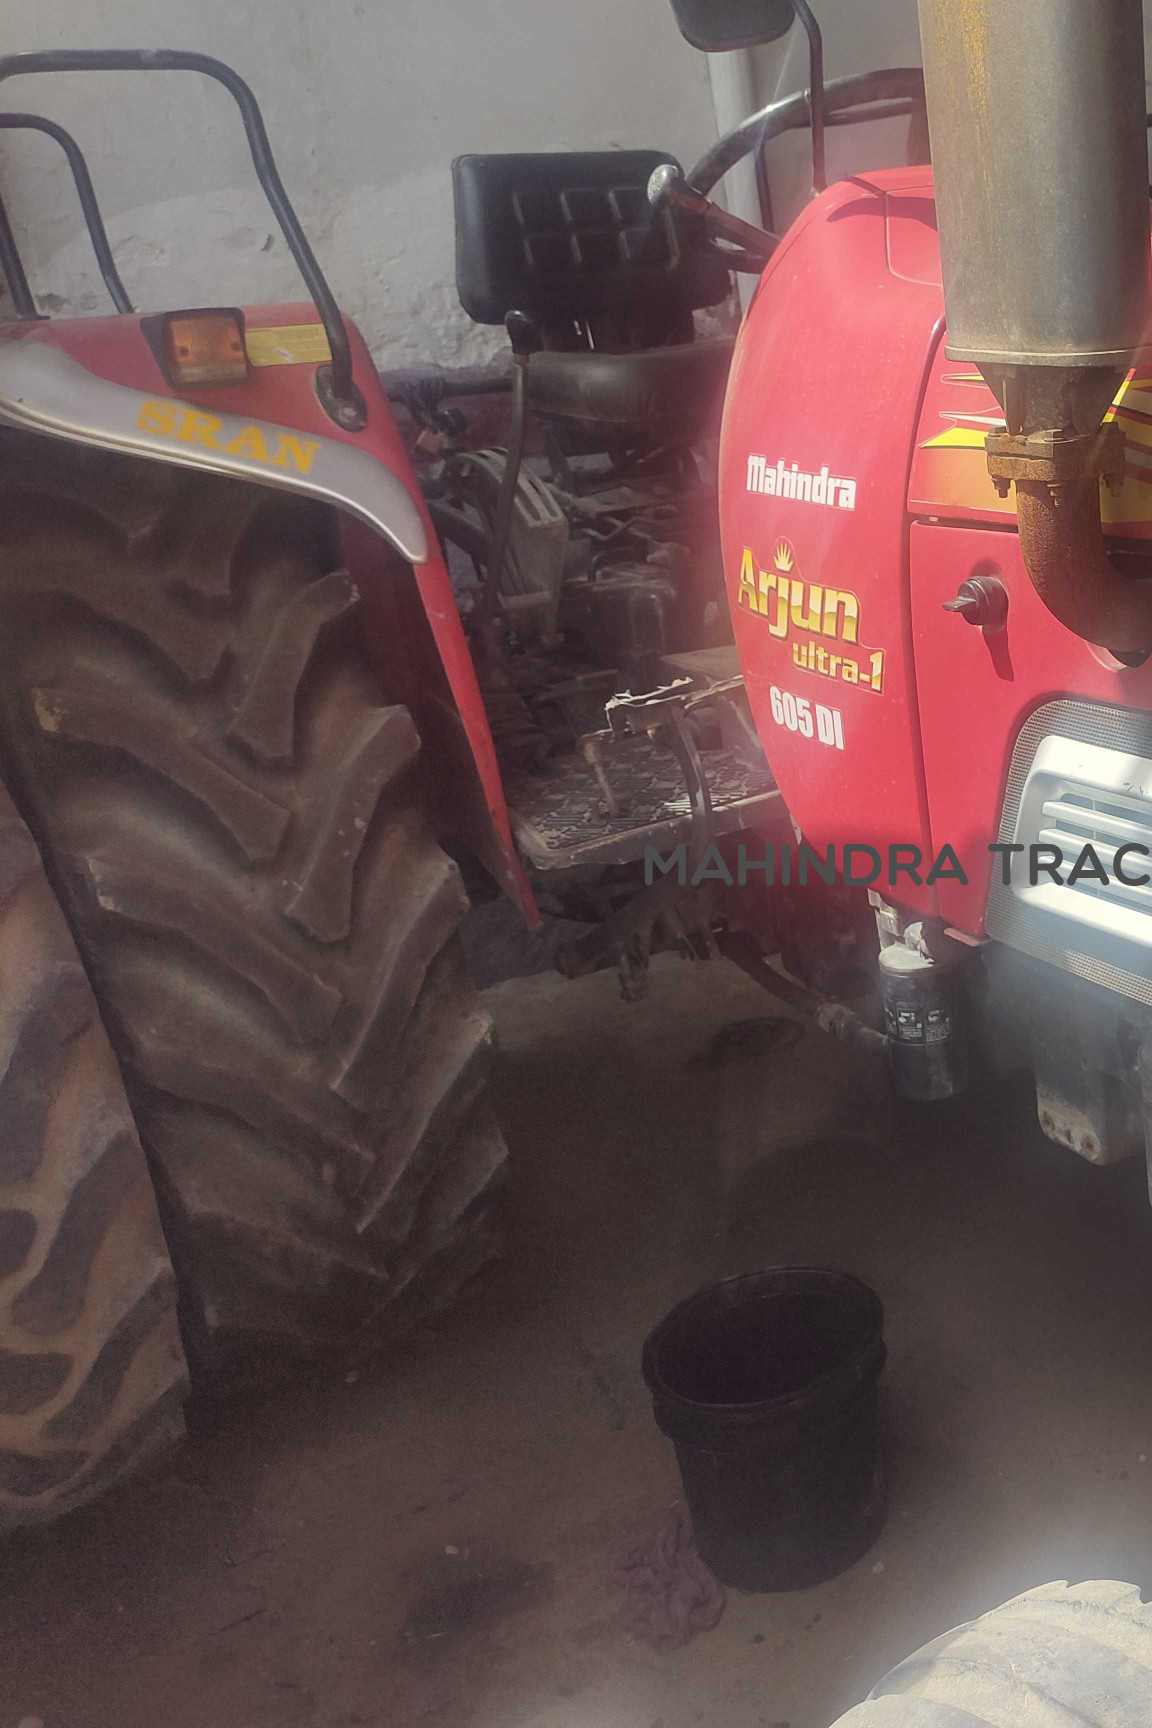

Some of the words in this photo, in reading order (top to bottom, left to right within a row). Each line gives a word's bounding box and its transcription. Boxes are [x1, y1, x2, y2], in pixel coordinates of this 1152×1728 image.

[137, 401, 321, 473] SRAN
[746, 454, 857, 510] Mahindra
[738, 543, 859, 643] Arjun
[792, 640, 884, 692] ultra-1
[769, 686, 815, 739] 605
[815, 704, 845, 750] DI
